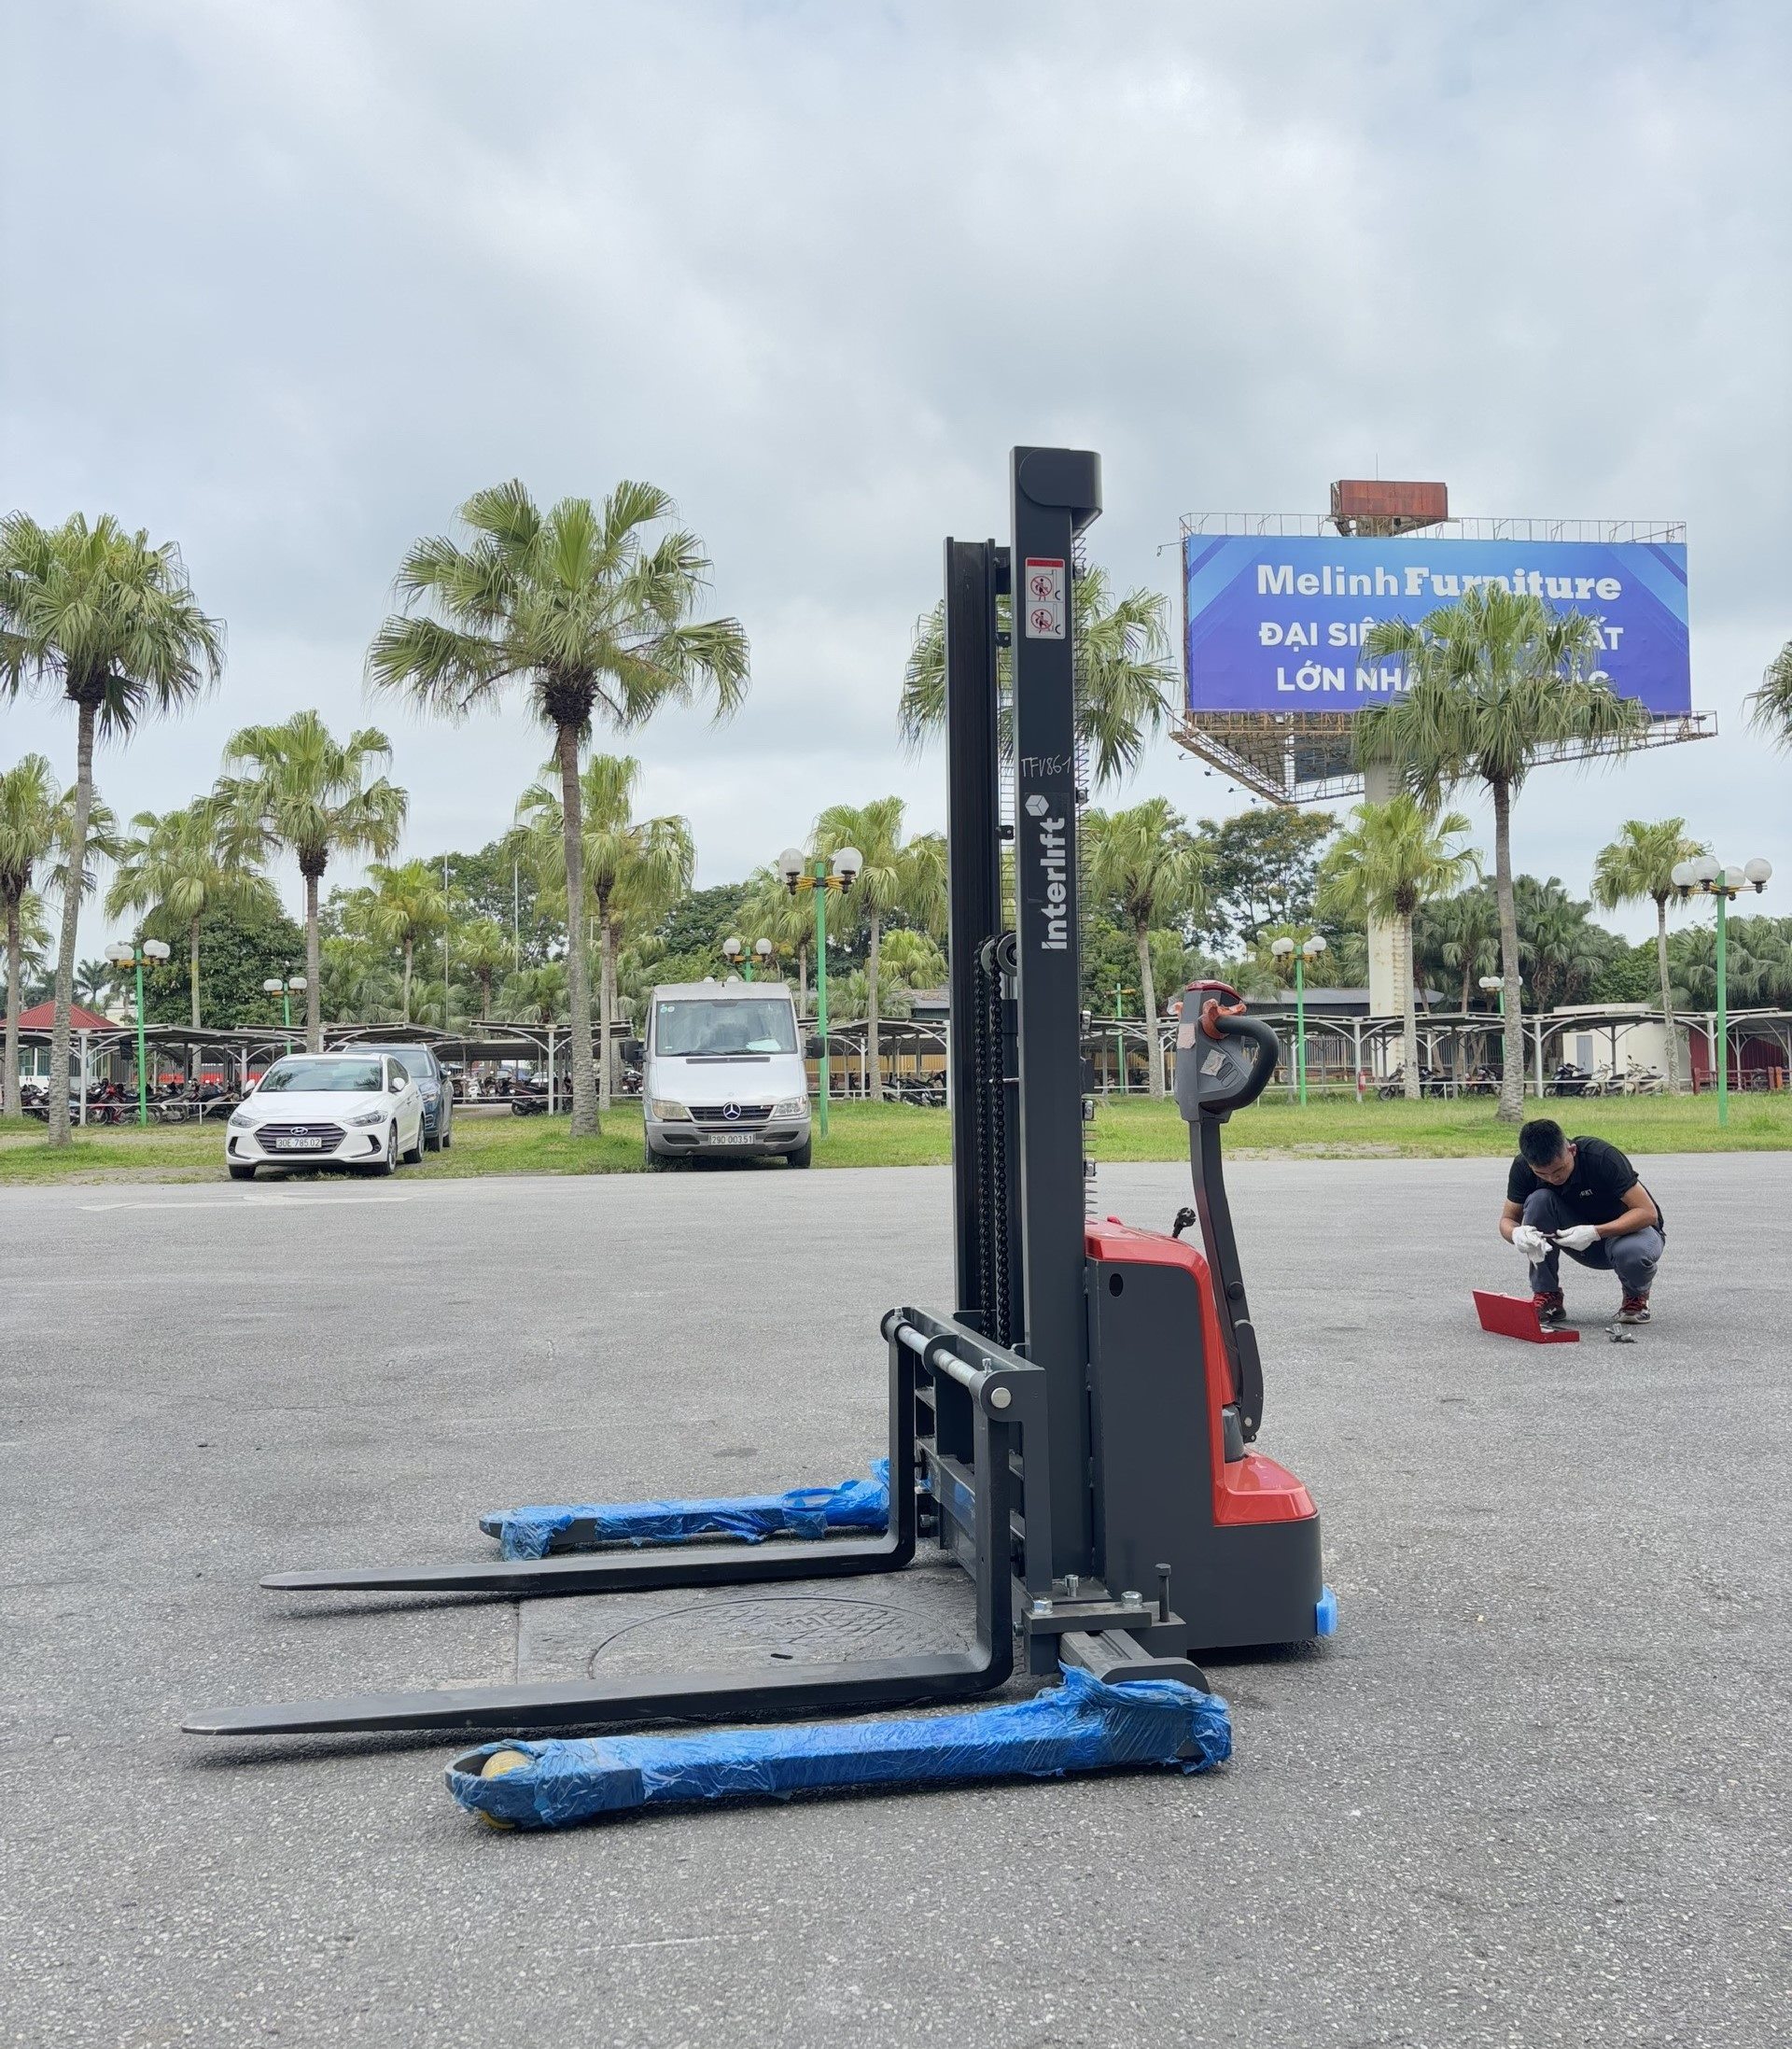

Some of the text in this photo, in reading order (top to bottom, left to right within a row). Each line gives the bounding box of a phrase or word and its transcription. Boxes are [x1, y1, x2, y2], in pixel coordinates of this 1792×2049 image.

[1259, 622, 1318, 652] ĐẠI
[1328, 616, 1395, 647] SIÊ
[1277, 660, 1345, 692] LỚN
